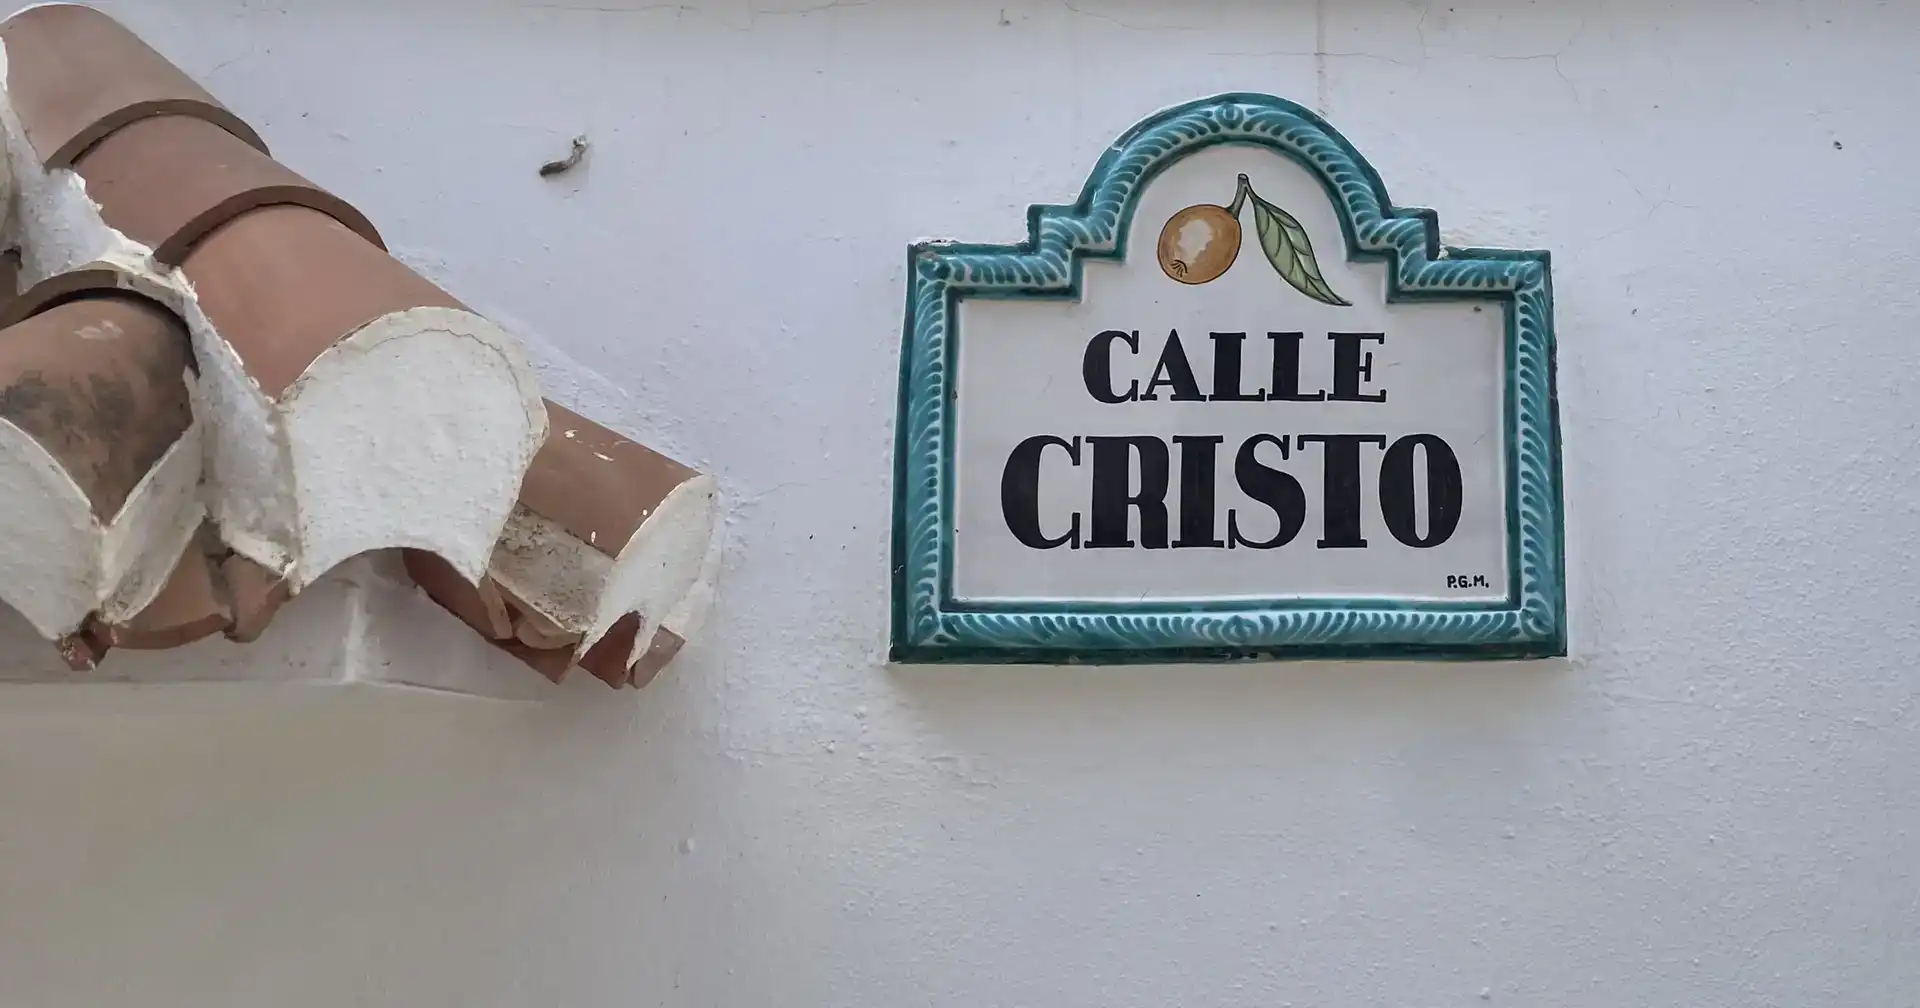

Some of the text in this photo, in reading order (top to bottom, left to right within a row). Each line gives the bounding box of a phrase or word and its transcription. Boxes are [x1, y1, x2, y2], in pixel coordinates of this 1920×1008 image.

[1082, 329, 1387, 404] CALLE
[1000, 433, 1463, 550] CRISTO
[1446, 574, 1490, 589] P.G.M.
